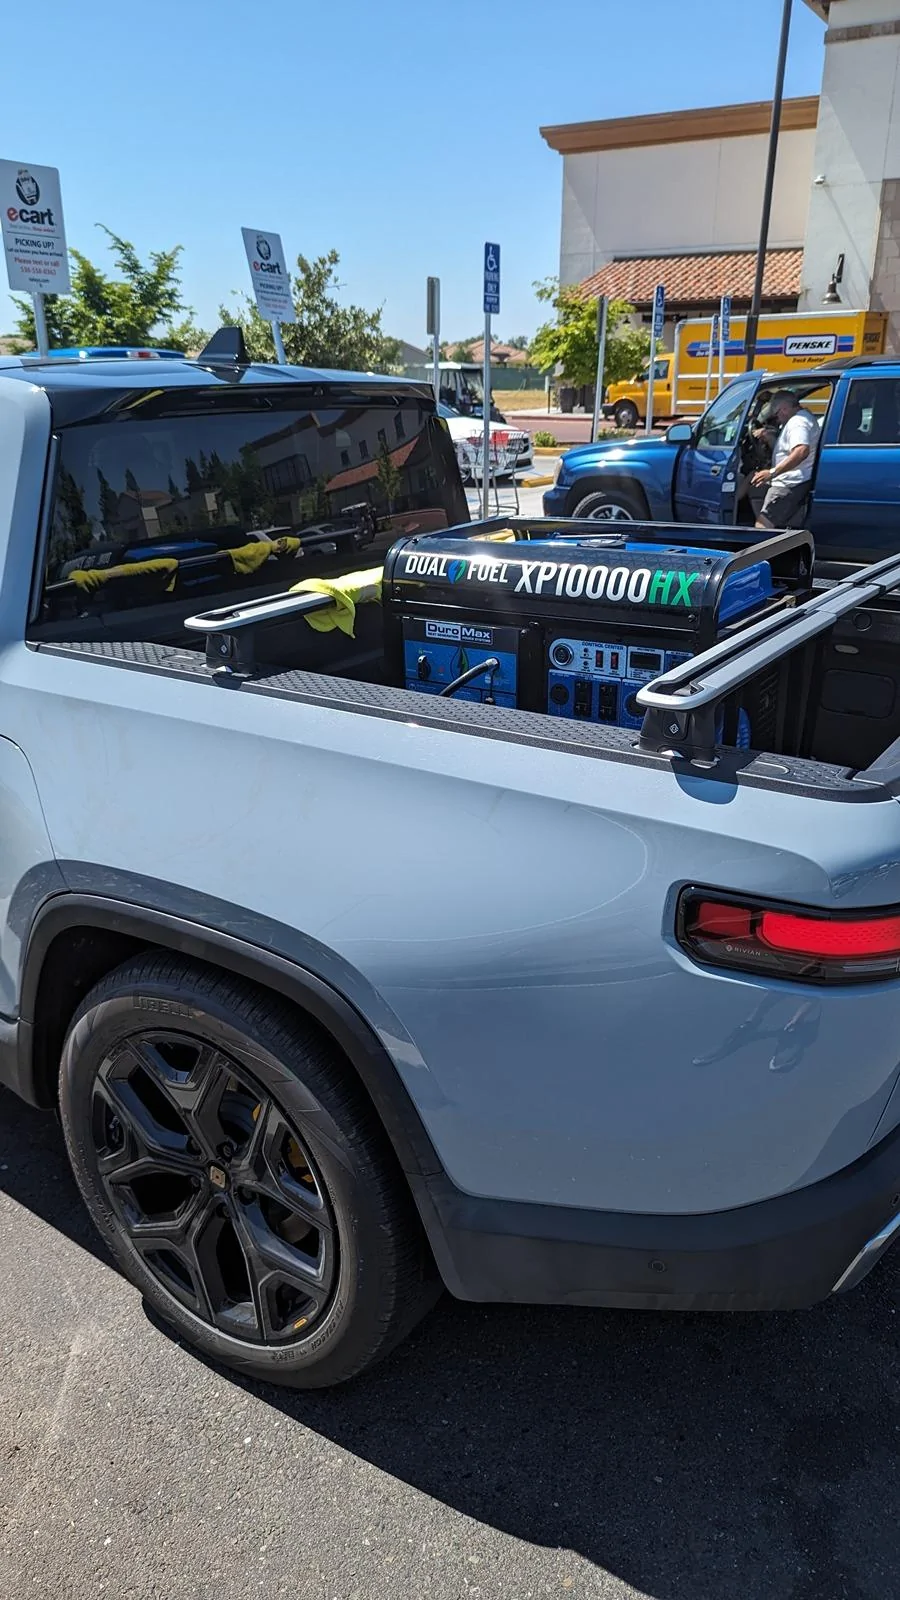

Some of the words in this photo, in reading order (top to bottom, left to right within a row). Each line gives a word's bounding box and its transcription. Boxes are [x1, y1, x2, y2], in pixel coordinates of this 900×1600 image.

[7, 207, 55, 226] ecart
[15, 238, 42, 249] PICKING
[42, 241, 55, 250] UP?
[253, 261, 282, 275] ecart
[788, 340, 833, 350] PENSKE
[404, 554, 448, 577] DUAL
[466, 561, 509, 584] FUEL
[514, 561, 700, 607] XP10000HX
[734, 946, 761, 956] RIVIAN
